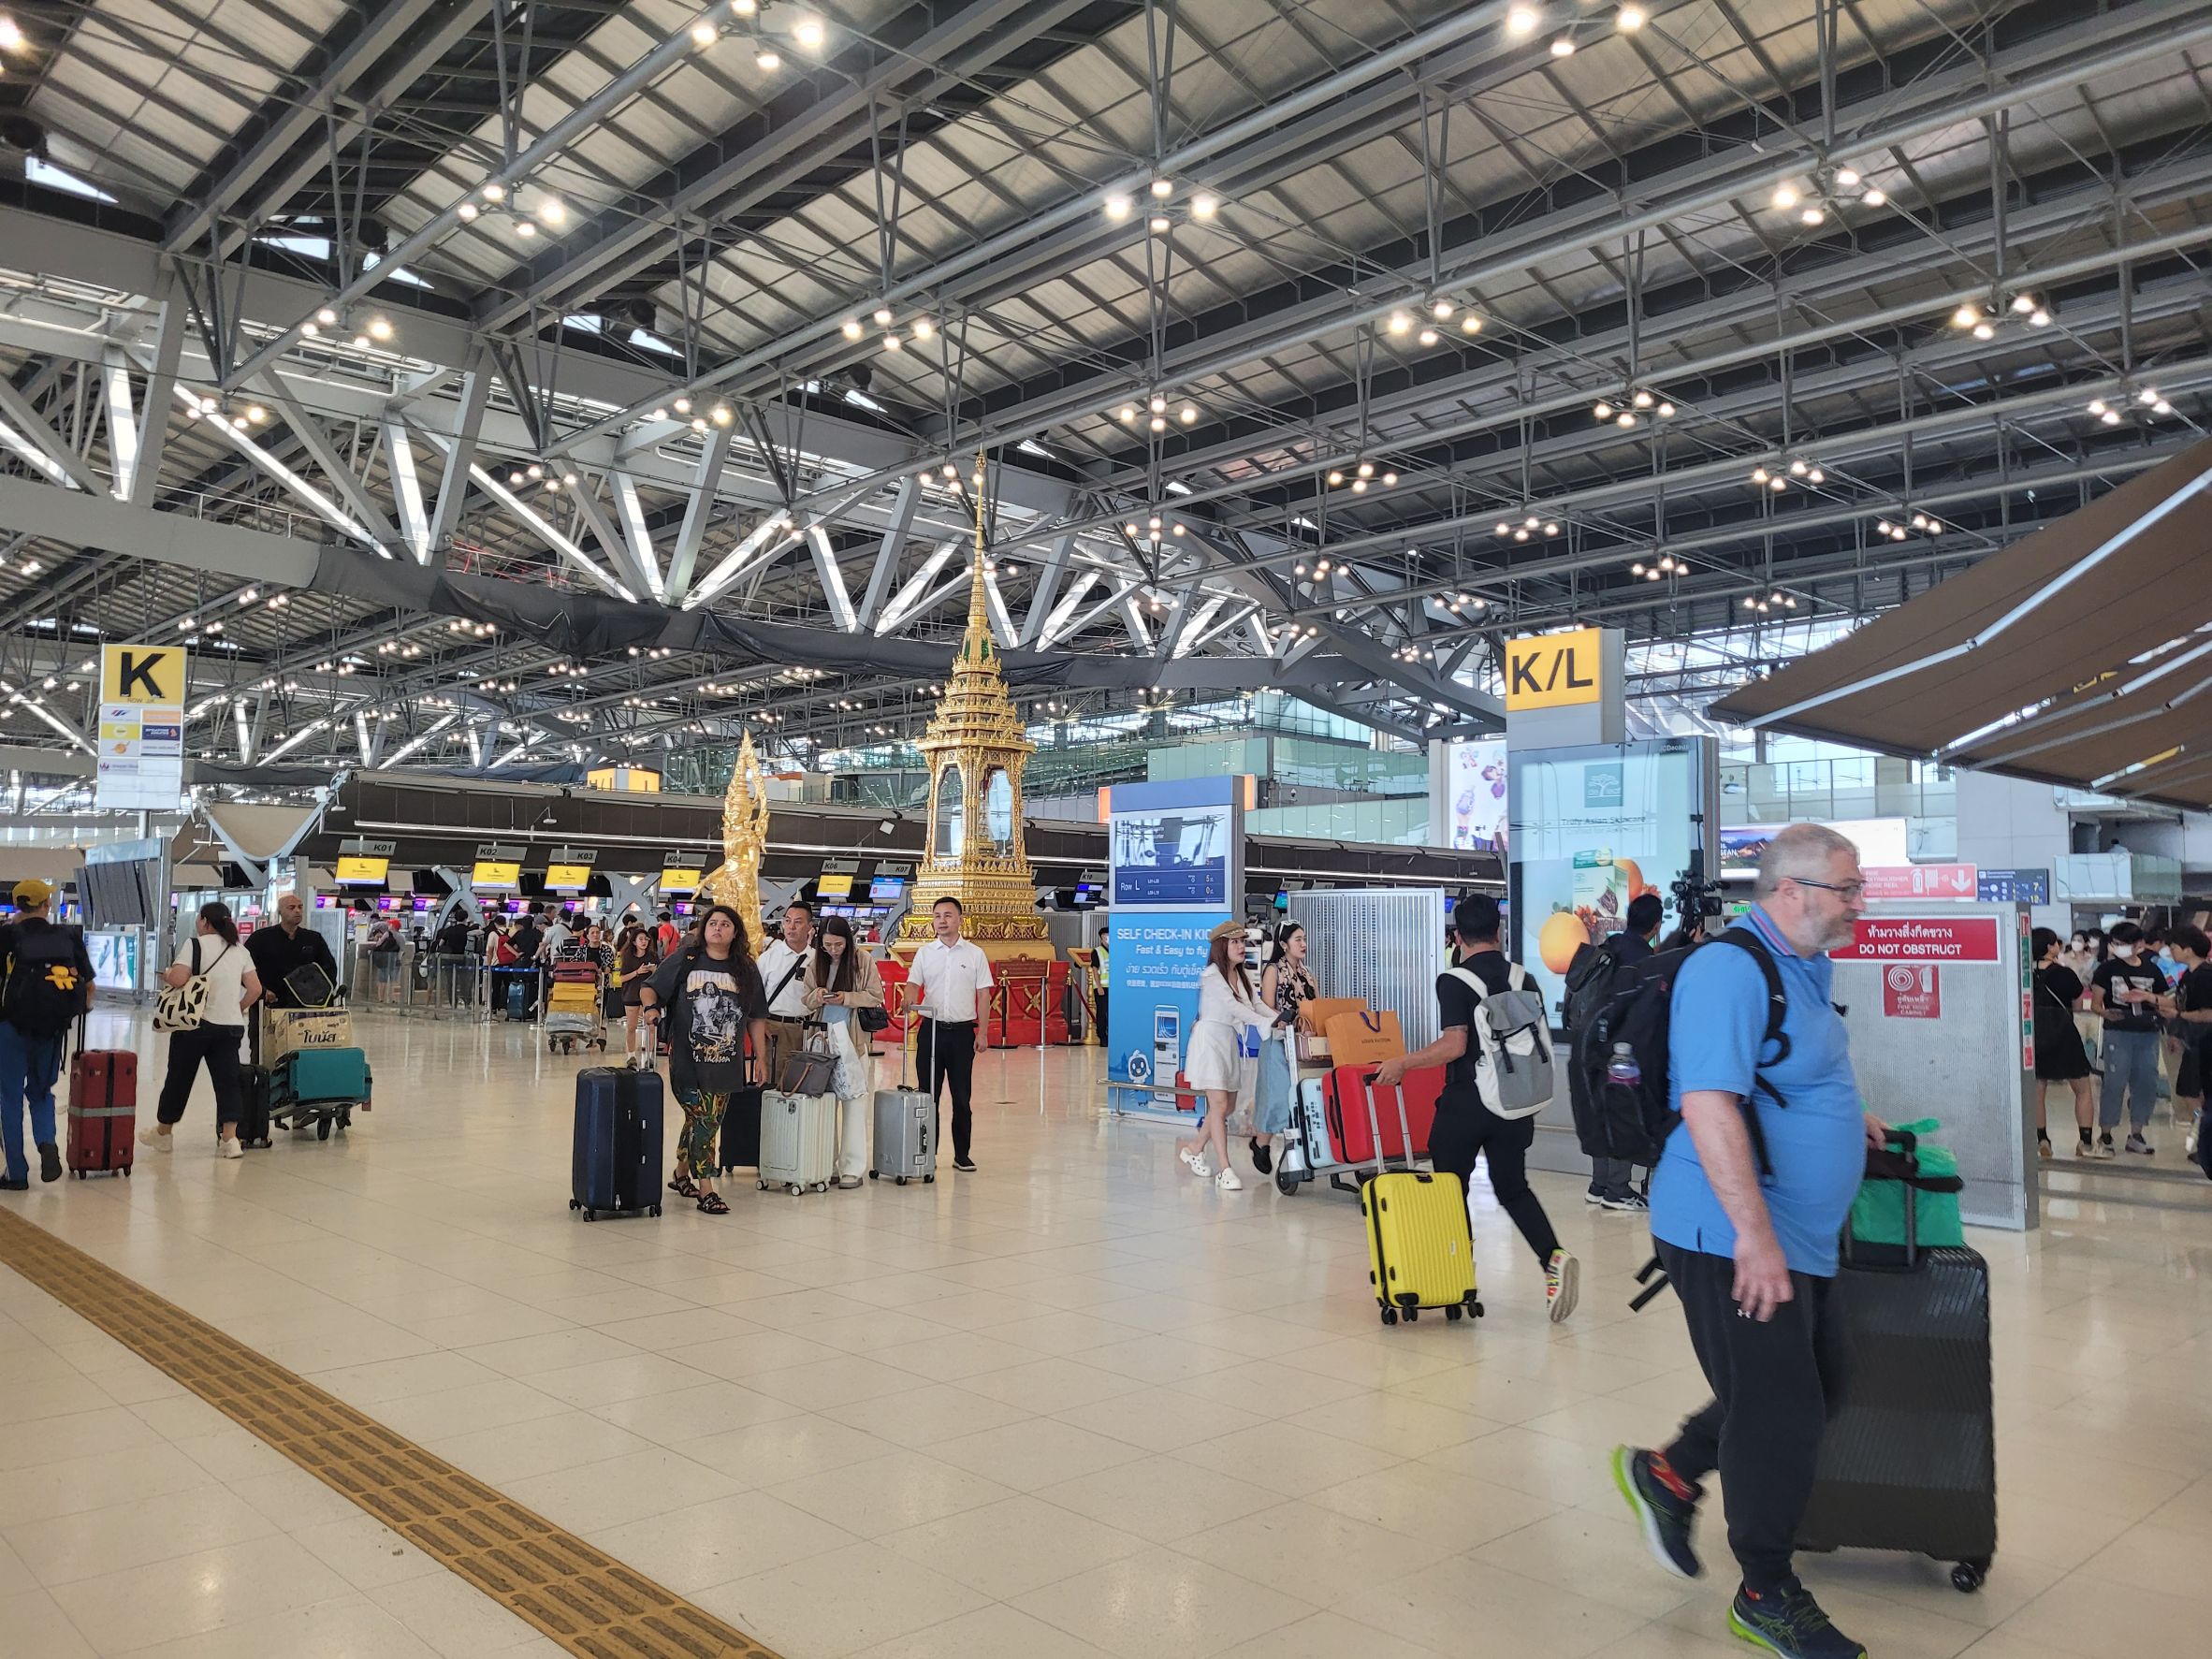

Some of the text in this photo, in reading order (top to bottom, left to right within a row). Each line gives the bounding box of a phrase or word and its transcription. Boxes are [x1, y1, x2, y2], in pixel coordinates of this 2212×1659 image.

[120, 651, 167, 698] K
[1512, 648, 1594, 695] K/L
[373, 844, 392, 852] K01
[480, 848, 498, 856] K02
[667, 855, 682, 864] K04
[1120, 879, 1141, 891] Row L
[1116, 928, 1213, 940] SELF CHECK-IN KIO
[1868, 921, 1953, 939] ห้ามวางสิ่งกีดขวาง
[1136, 944, 1208, 958] Fast & Easy to fly
[1859, 943, 1961, 955] DO NOT OBSTRUCT
[1126, 962, 1141, 974] ง่าย
[1142, 962, 1169, 974] รวดเร็ว
